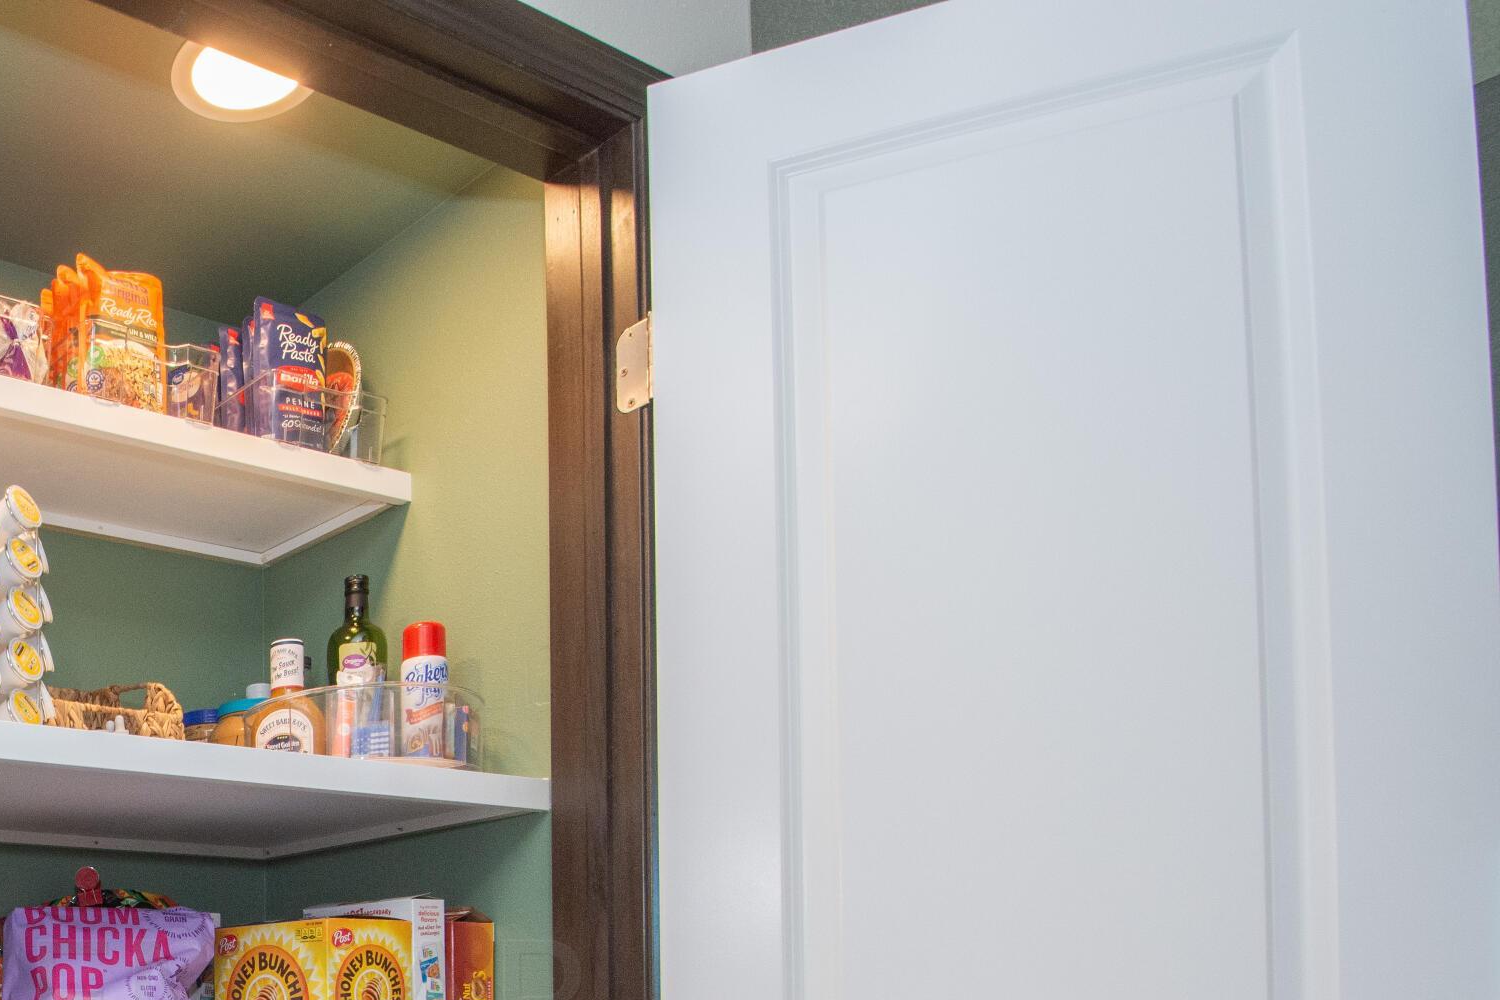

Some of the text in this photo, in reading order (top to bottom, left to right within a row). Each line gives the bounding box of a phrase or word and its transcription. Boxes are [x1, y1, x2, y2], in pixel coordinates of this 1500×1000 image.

[100, 298, 138, 325] Ready
[277, 324, 318, 352] Ready
[280, 341, 316, 364] Pasta
[280, 372, 318, 387] Barilla
[285, 397, 316, 409] PENNE
[24, 924, 175, 968] CHICKA
[220, 937, 237, 953] Post
[333, 930, 352, 945] Post
[463, 983, 471, 1000] Nut
